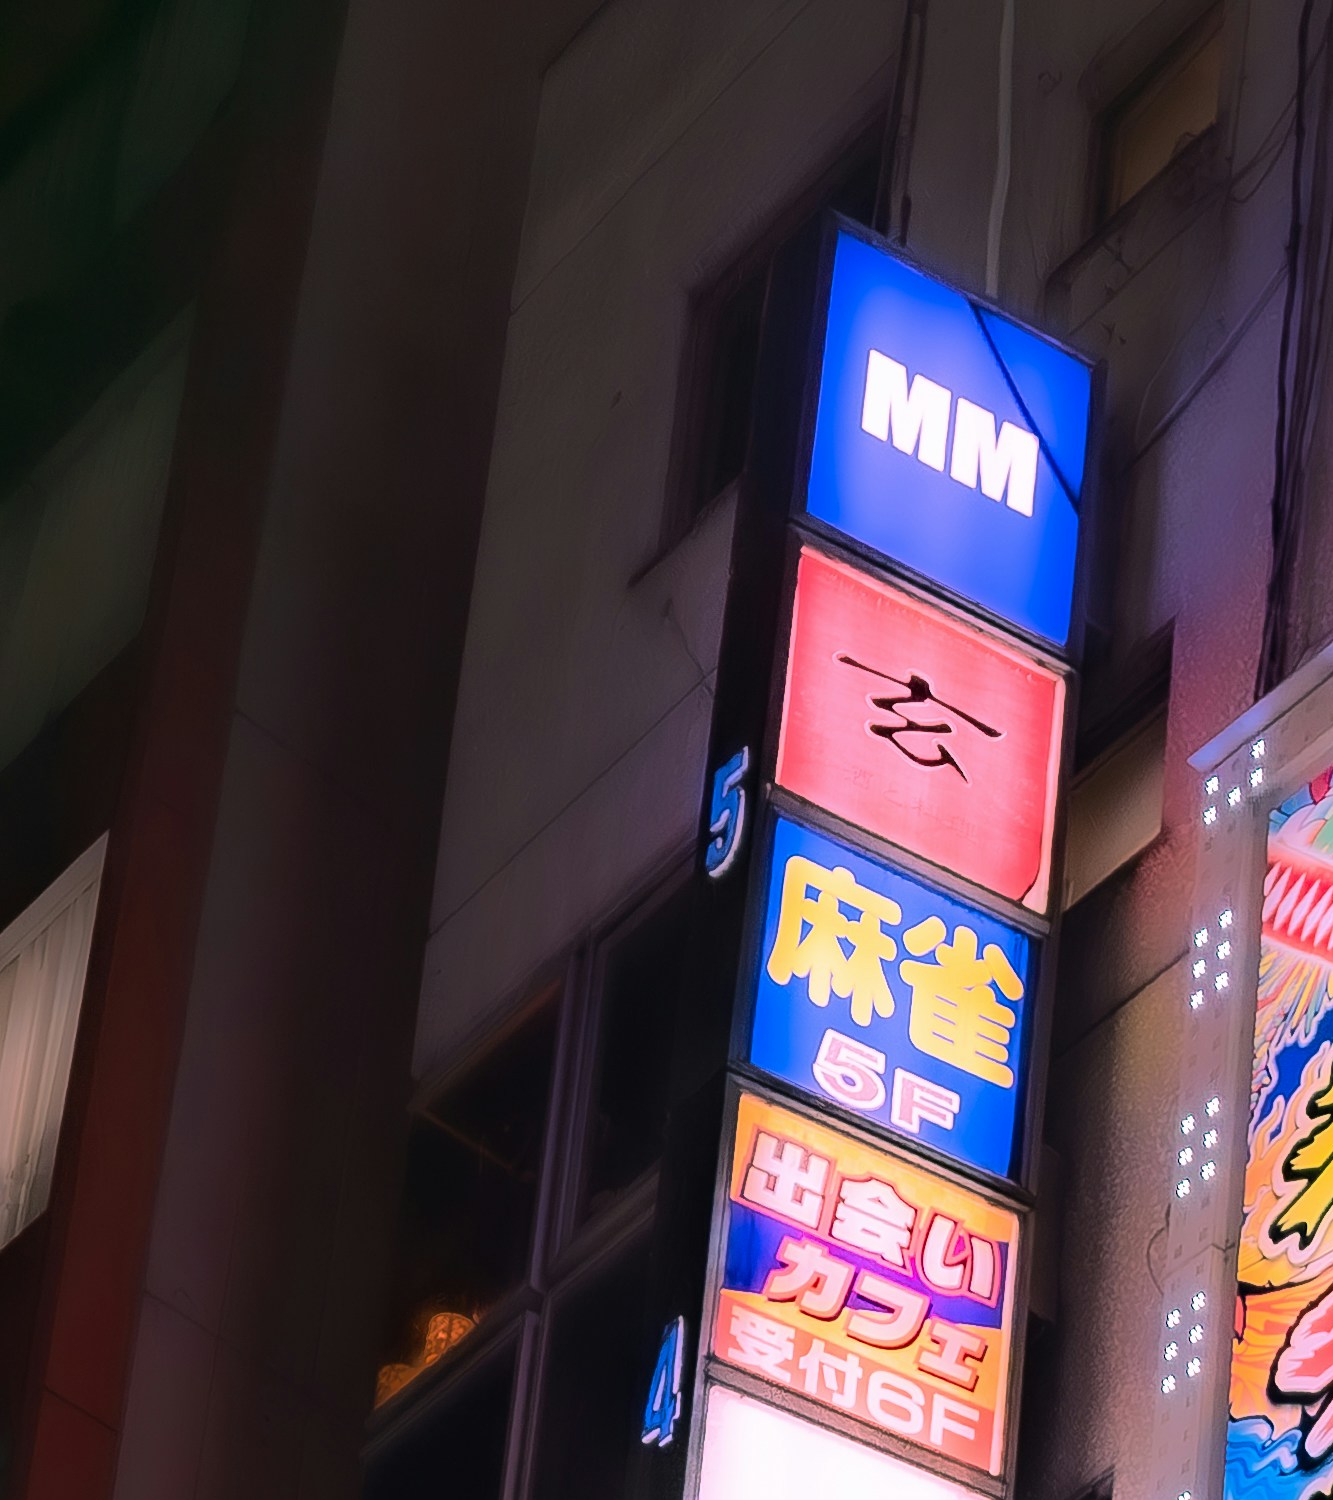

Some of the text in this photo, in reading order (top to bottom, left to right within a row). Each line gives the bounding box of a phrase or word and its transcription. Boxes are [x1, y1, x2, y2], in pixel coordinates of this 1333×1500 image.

[860, 349, 1039, 517] MM
[836, 653, 1003, 784] 玄
[709, 746, 747, 877] 5
[767, 855, 1024, 1088] 麻雀
[812, 1028, 960, 1133] 5F
[742, 1129, 1003, 1307] 出会い
[642, 1316, 684, 1447] 4
[728, 1306, 982, 1445] 受付6F
[766, 1240, 987, 1389] カフェ
